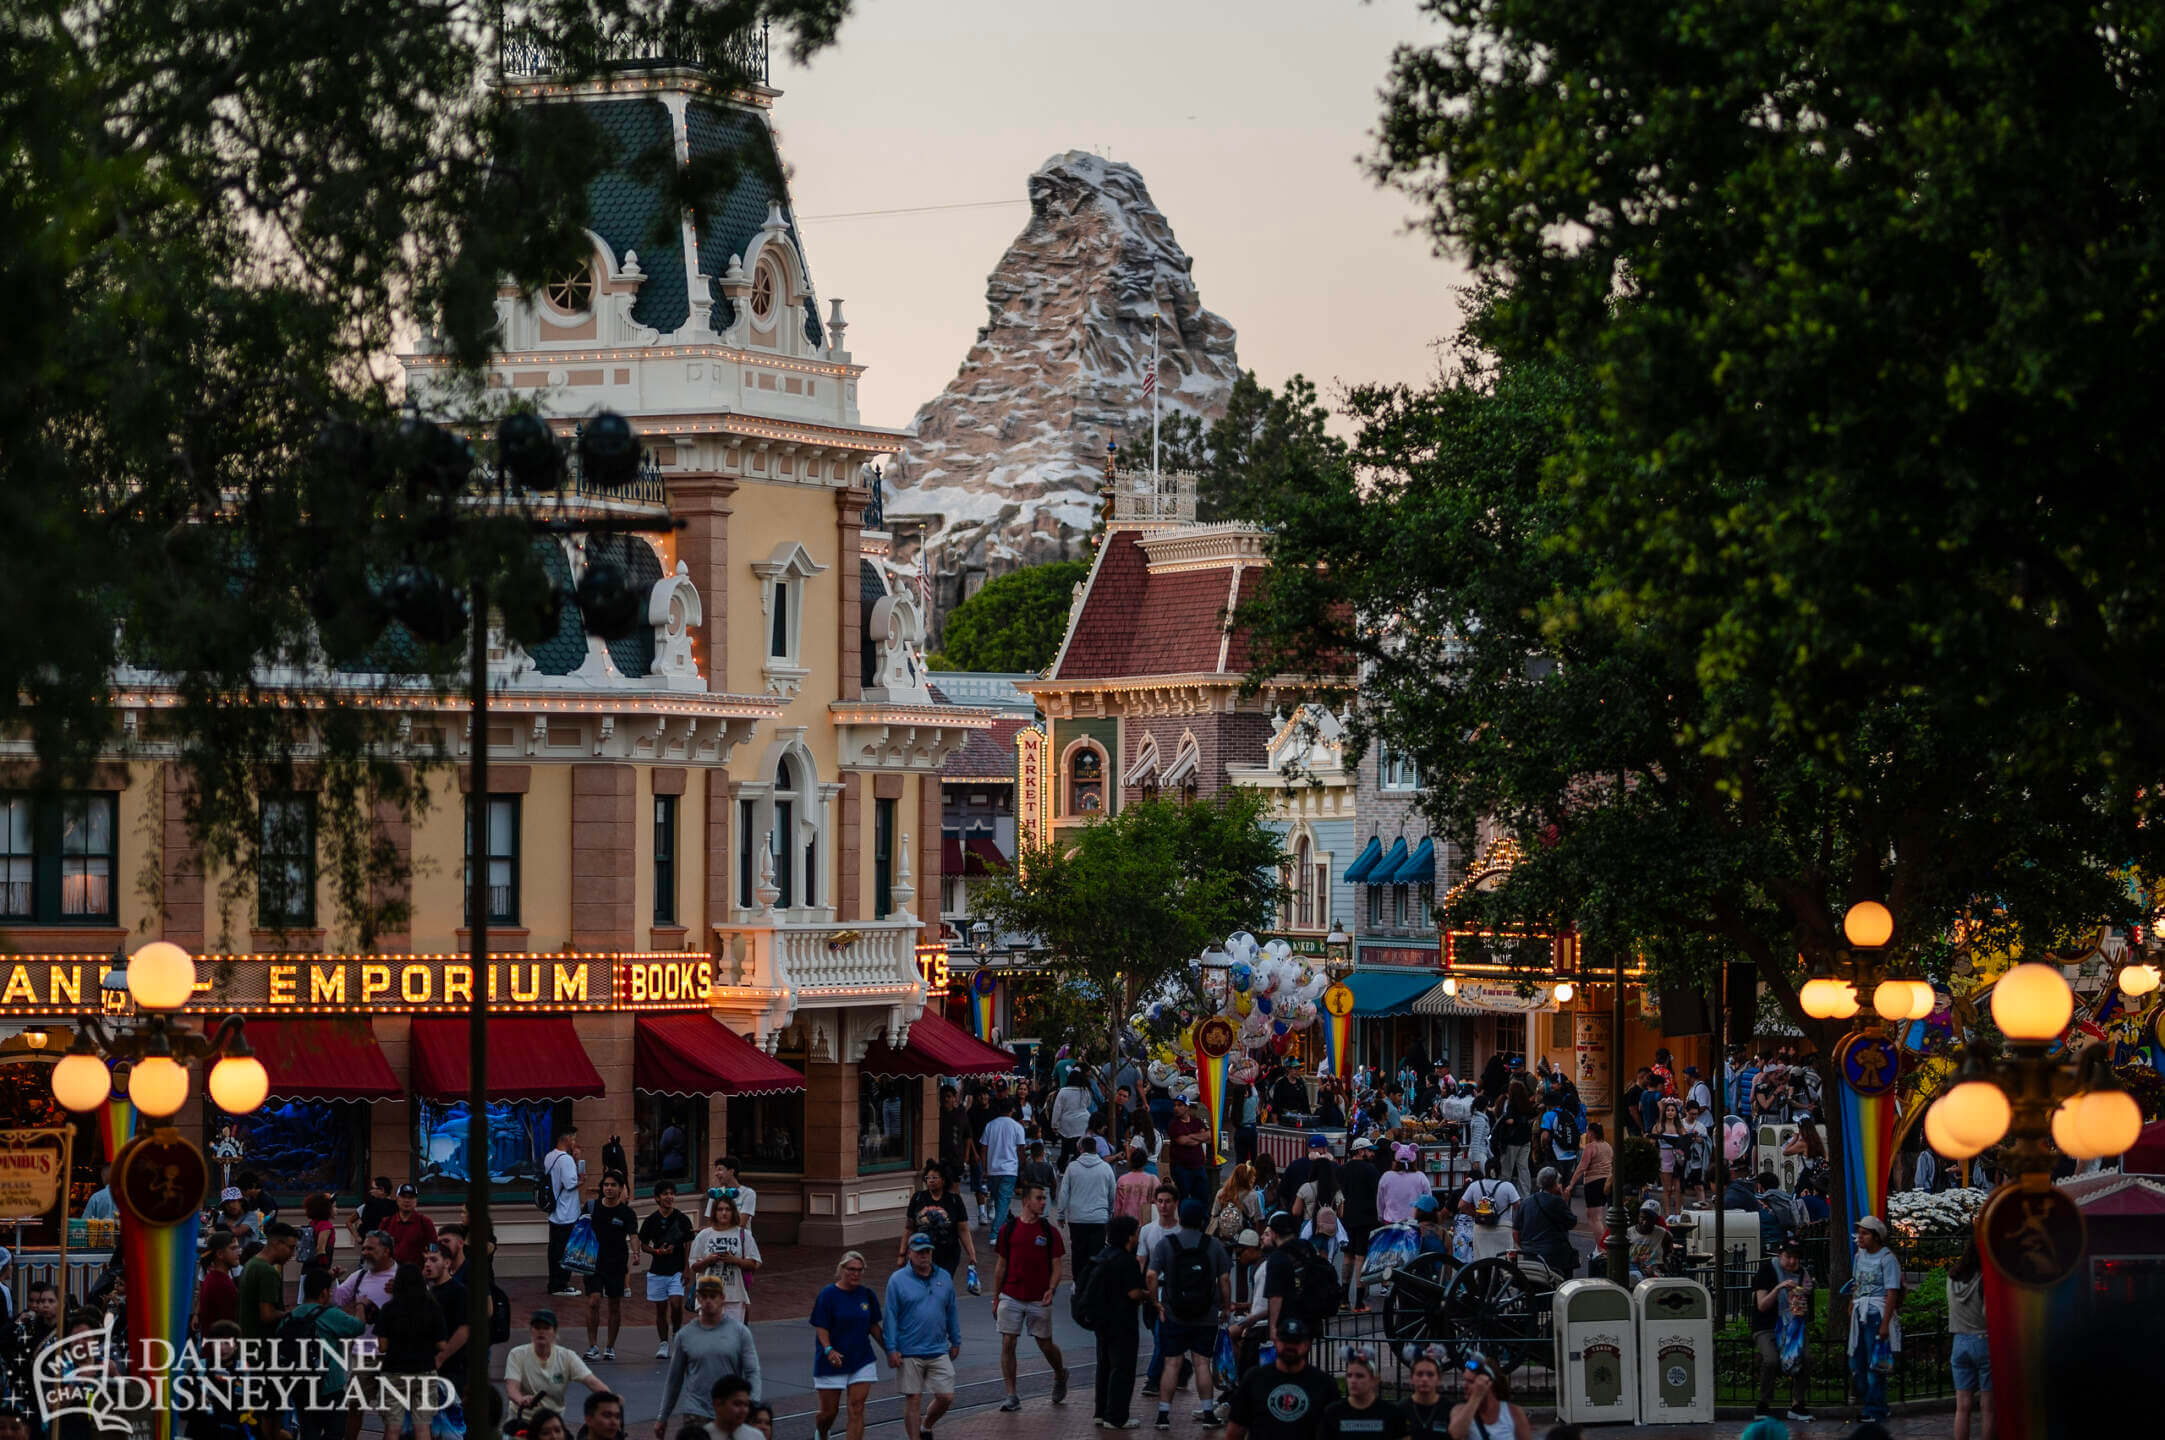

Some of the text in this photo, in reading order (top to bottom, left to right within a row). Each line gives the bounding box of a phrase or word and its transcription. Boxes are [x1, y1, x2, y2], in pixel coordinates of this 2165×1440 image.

[1025, 740, 1037, 811] MARKET
[269, 963, 589, 1004] EMPORIUM
[631, 962, 712, 1002] BOOKS
[915, 953, 949, 988] TS
